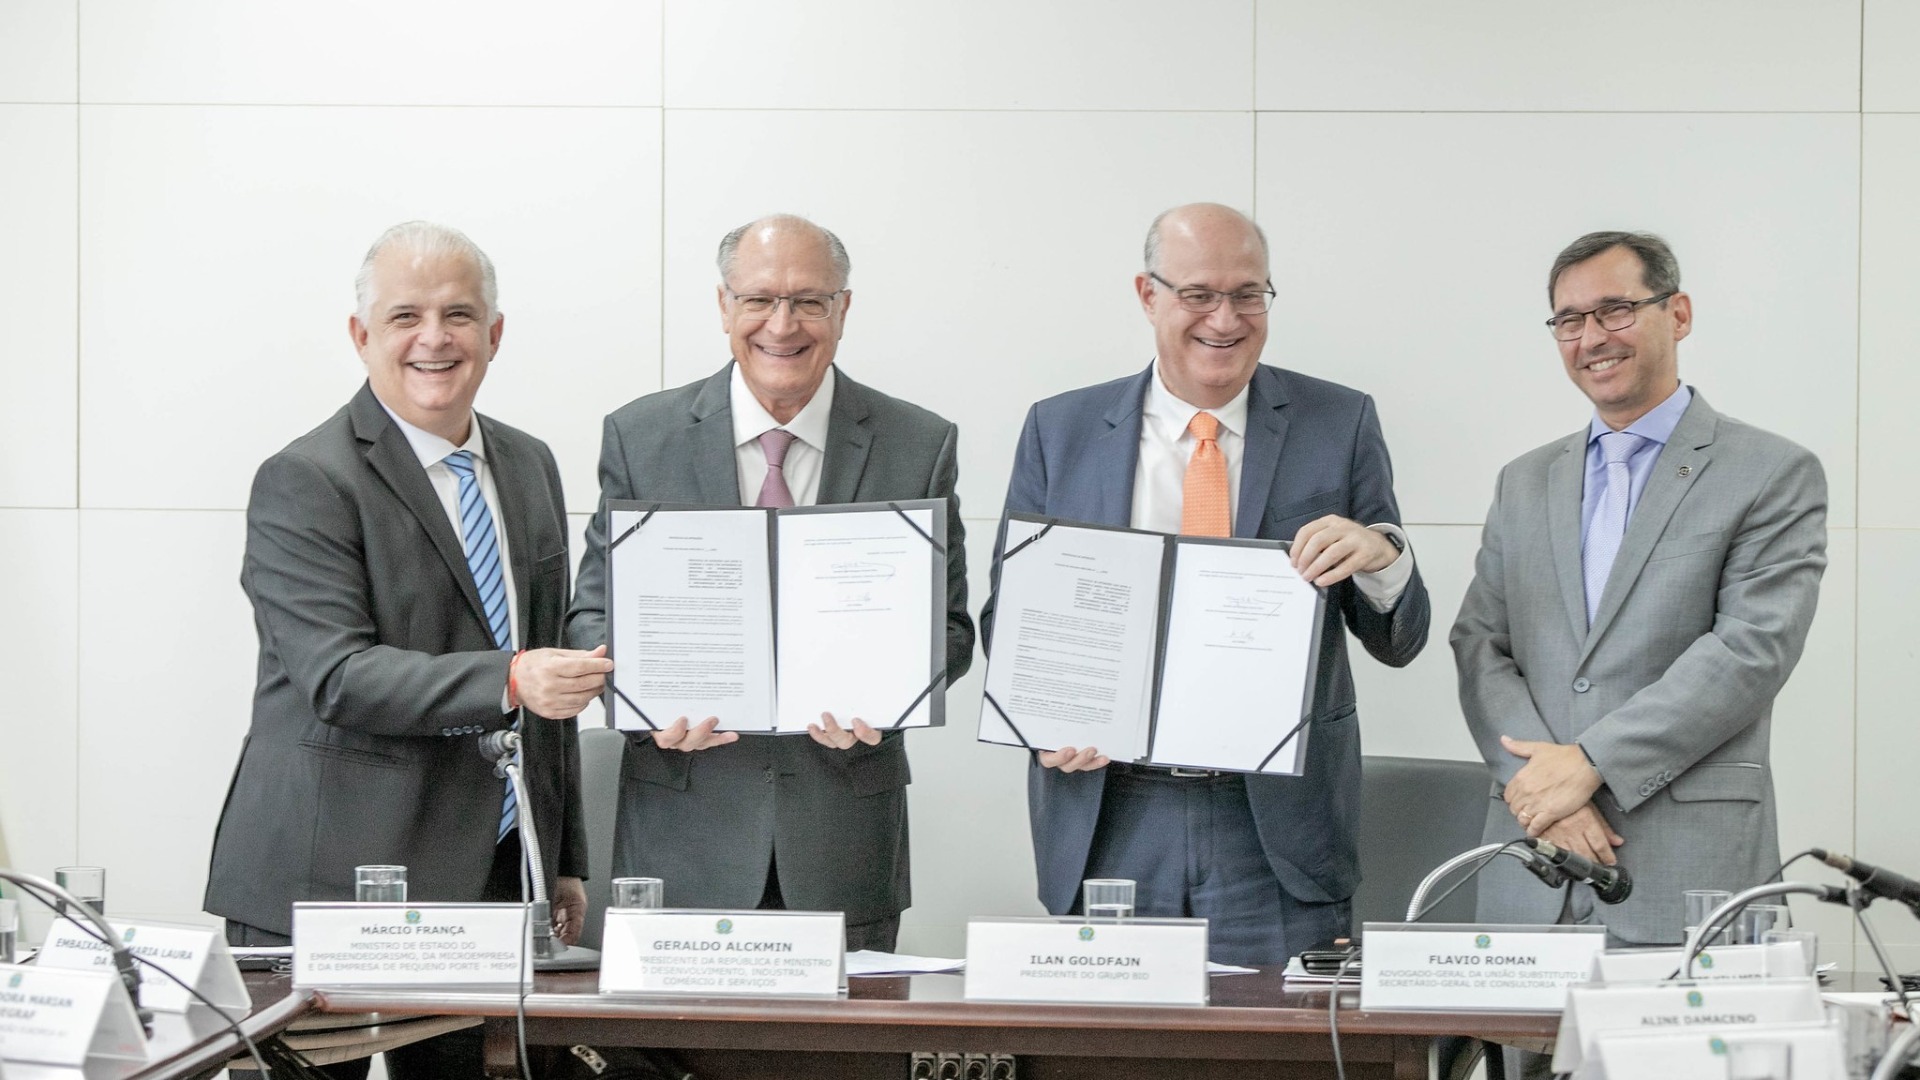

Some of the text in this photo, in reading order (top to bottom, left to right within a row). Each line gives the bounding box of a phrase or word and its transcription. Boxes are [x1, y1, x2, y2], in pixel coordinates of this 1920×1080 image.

[361, 924, 466, 937] MÁRCIO FRANÇA
[350, 941, 476, 950] MINISTRO DE ESTADO DO
[653, 940, 793, 952] GERALDO ALCKMIN
[161, 948, 193, 960] LAURA
[422, 952, 436, 961] DA
[439, 952, 516, 960] MICROEMPRESA
[701, 957, 715, 965] DA
[718, 955, 771, 967] REPÚBLICA
[774, 958, 779, 966] E
[783, 958, 832, 968] MINISTRO
[1030, 955, 1141, 967] ILAN GOLDFAJN
[1429, 955, 1537, 966] FLAVIO ROMAN
[308, 963, 314, 972] E
[317, 963, 331, 972] DA
[334, 963, 380, 972] EMPRESA
[383, 963, 396, 971] DE
[400, 963, 446, 973] PEQUENO
[449, 962, 480, 971] PORTE
[1020, 970, 1150, 981] PRESIDENTE DO GRUPO BID
[1378, 970, 1466, 979] ADVOGADO-GERAL
[1469, 970, 1482, 979] DA
[1485, 968, 1515, 979] UNIÃO
[1519, 971, 1578, 980] SUBSTITUTO
[663, 976, 777, 989] COMÉRCIO E SERVIÇOS
[1474, 980, 1486, 988] DE
[1489, 979, 1556, 988] CONSULTORIA
[1640, 1013, 1757, 1026] ALINE DAMACENO
